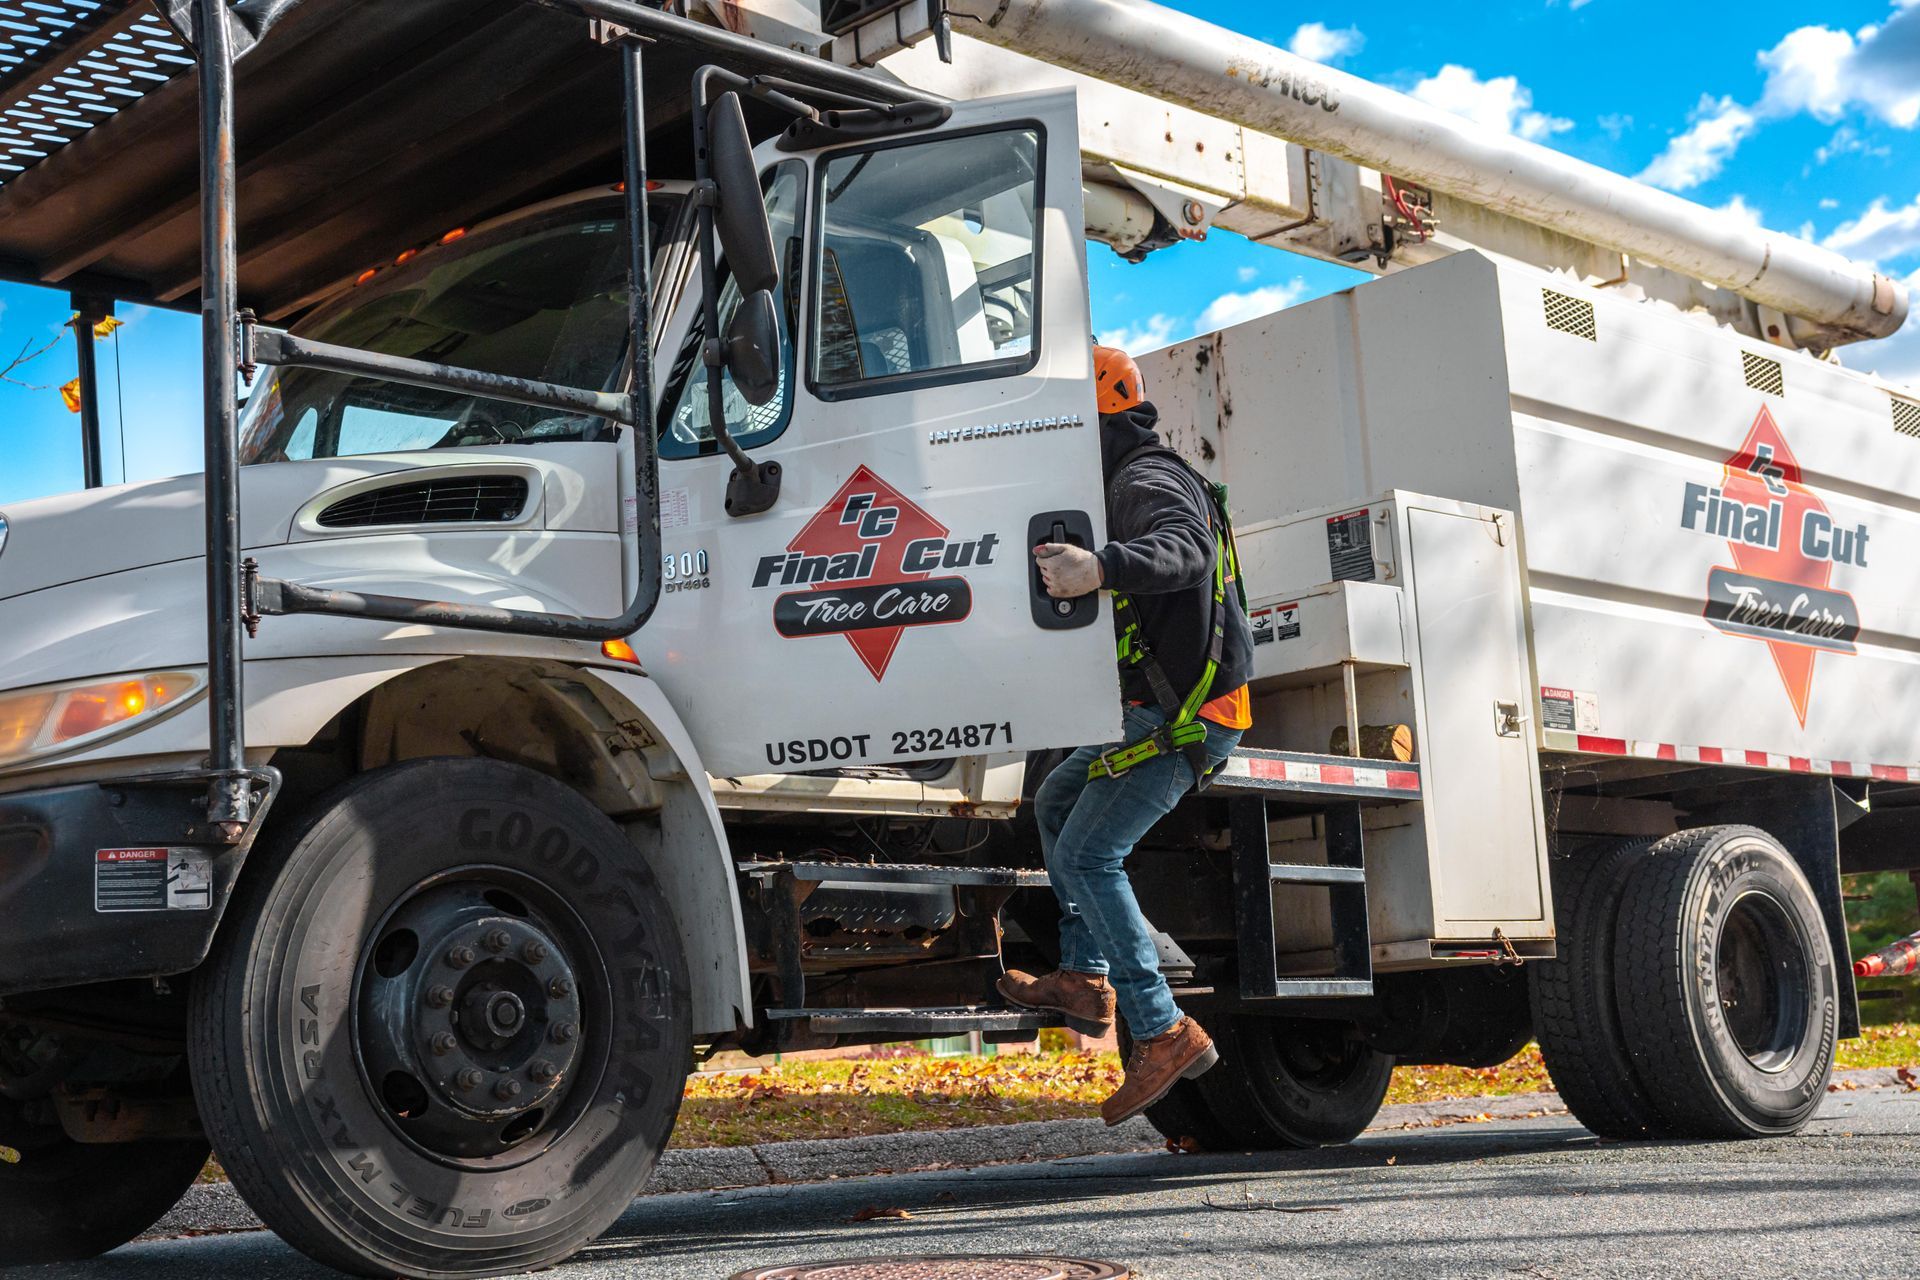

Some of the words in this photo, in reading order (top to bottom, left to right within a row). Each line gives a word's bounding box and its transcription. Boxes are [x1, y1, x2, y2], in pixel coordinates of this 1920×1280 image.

[928, 413, 1084, 446] INTERNATIONAL
[1680, 482, 1782, 549] Final
[1801, 511, 1870, 568] Cut
[752, 545, 879, 588] Final
[902, 533, 1000, 573] Cut
[664, 577, 711, 594] DT466
[796, 596, 868, 626] Tree
[873, 587, 951, 620] Care
[1724, 582, 1783, 627] Tree
[1784, 593, 1846, 639] Care
[1549, 689, 1571, 699] DANGER
[766, 734, 871, 765] USDOT
[892, 721, 1013, 754] 2324871
[119, 850, 156, 859] DANGER
[458, 808, 661, 1110] GOODYEAR
[300, 984, 323, 1080] RSA
[314, 1096, 383, 1185] MAX
[390, 1182, 492, 1229] FUEL
